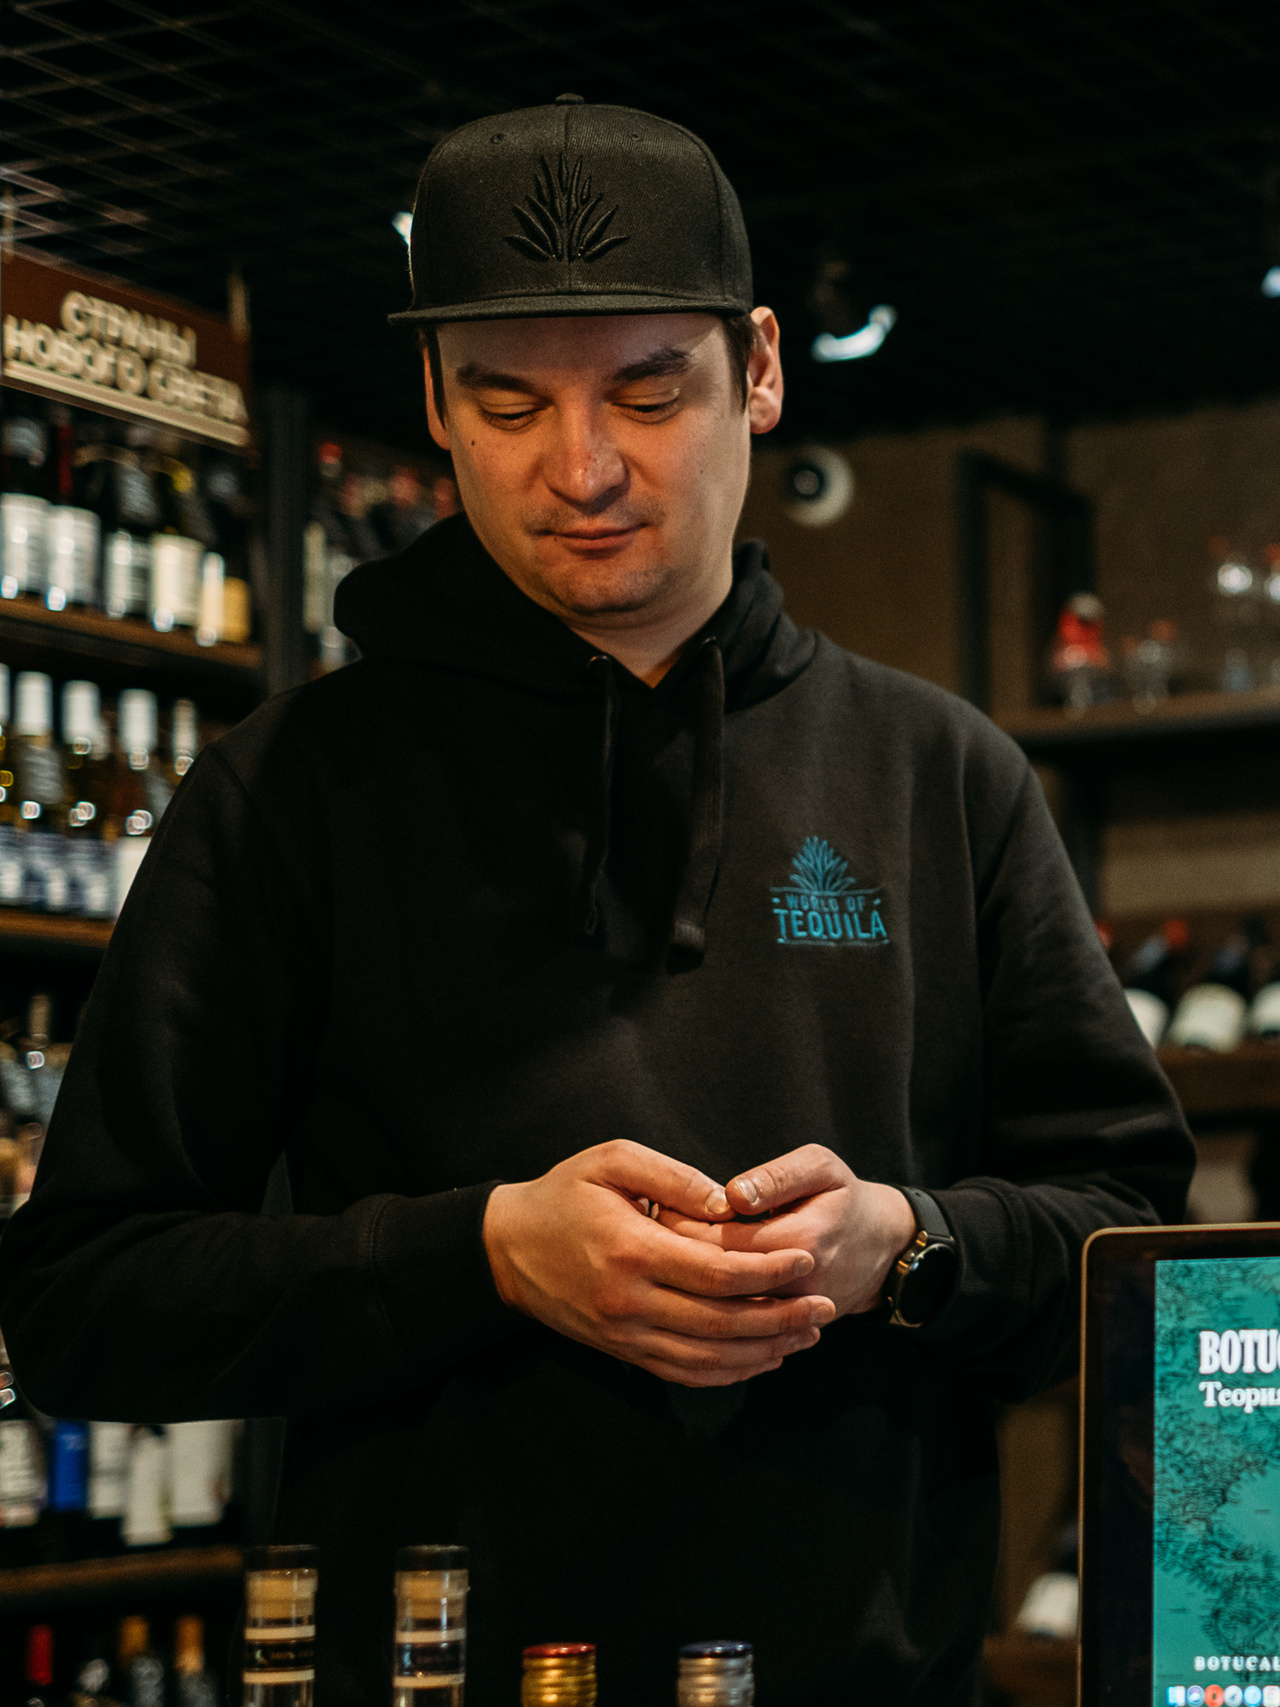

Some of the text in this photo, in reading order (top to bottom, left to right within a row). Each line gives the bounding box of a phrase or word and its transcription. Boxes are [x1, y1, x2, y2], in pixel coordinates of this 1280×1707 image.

[3, 314, 146, 396] НОВОГО
[786, 894, 865, 912] WORLD OF
[773, 908, 887, 939] TEQUILA
